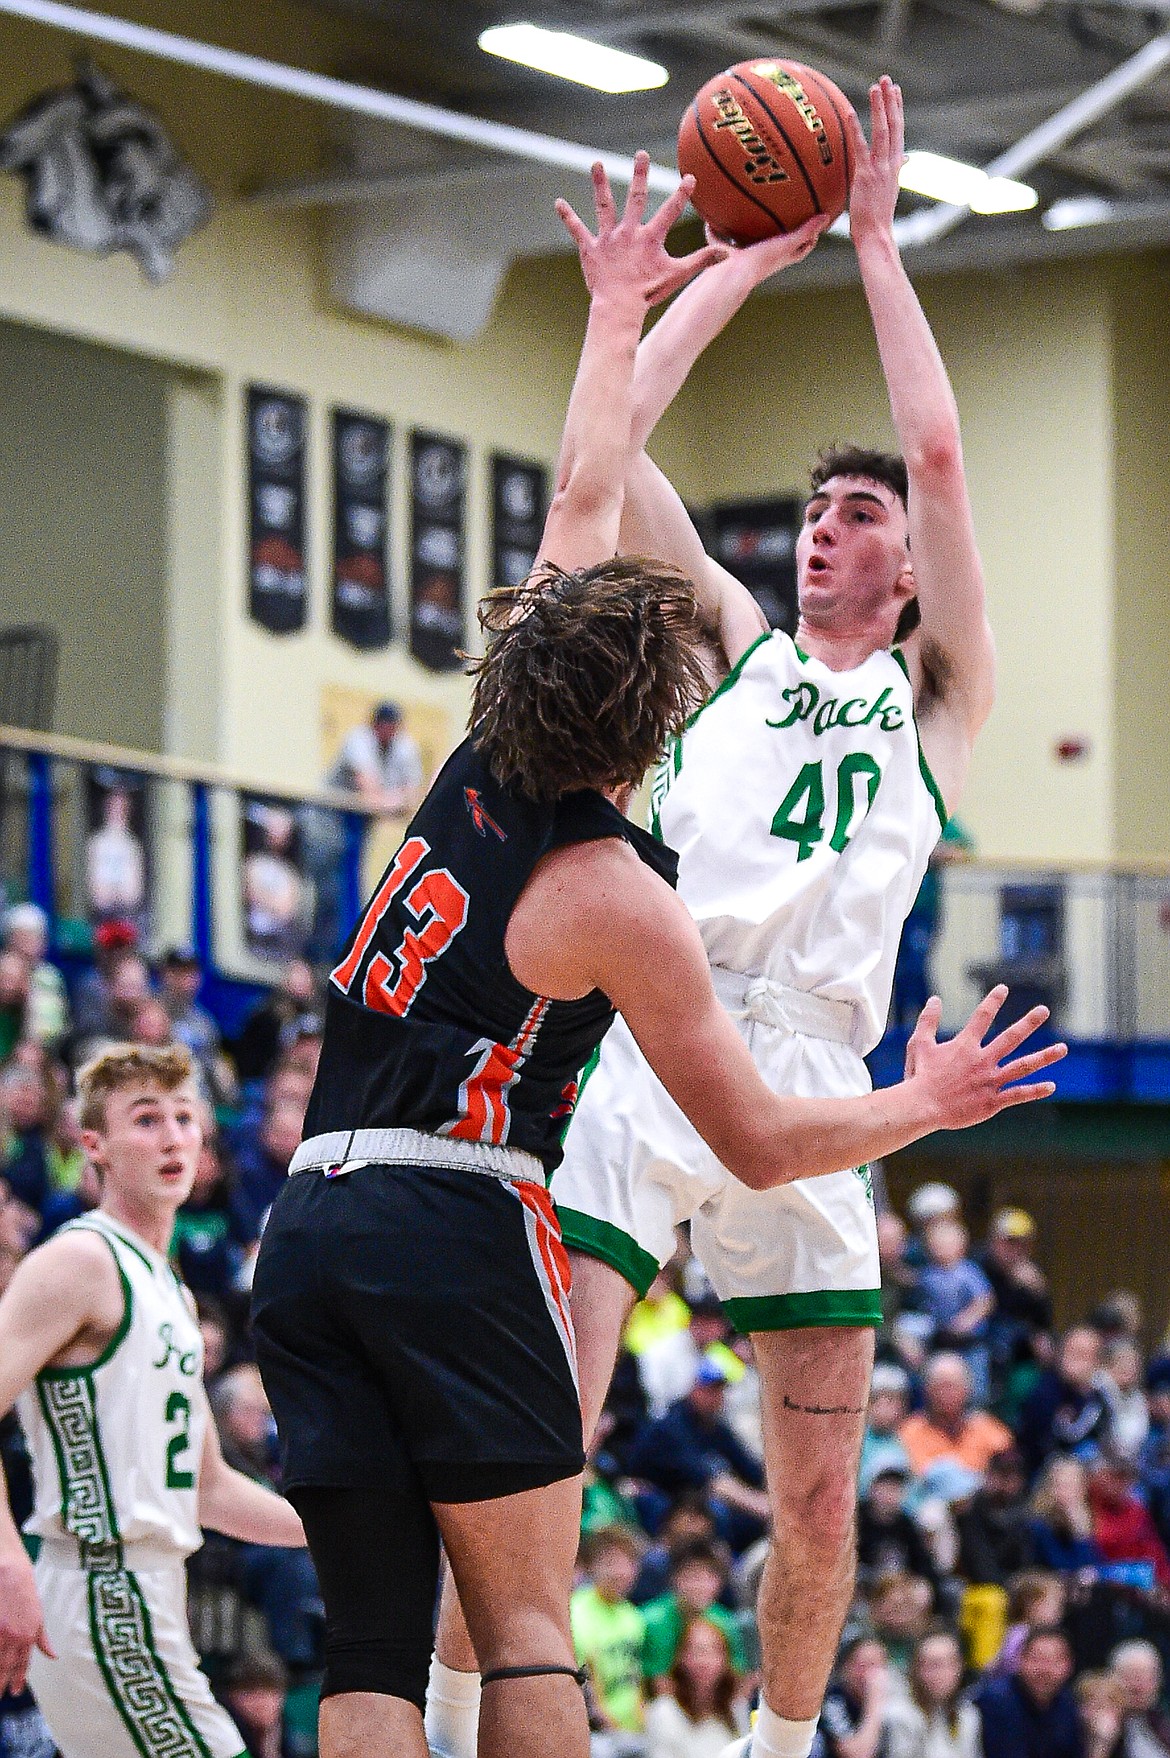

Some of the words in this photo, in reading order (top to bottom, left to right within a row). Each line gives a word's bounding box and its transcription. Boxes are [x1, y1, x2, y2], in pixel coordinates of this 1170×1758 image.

[765, 682, 904, 736] Pack
[770, 752, 881, 862] 40
[330, 836, 470, 1018] 13
[165, 1391, 194, 1489] 2
